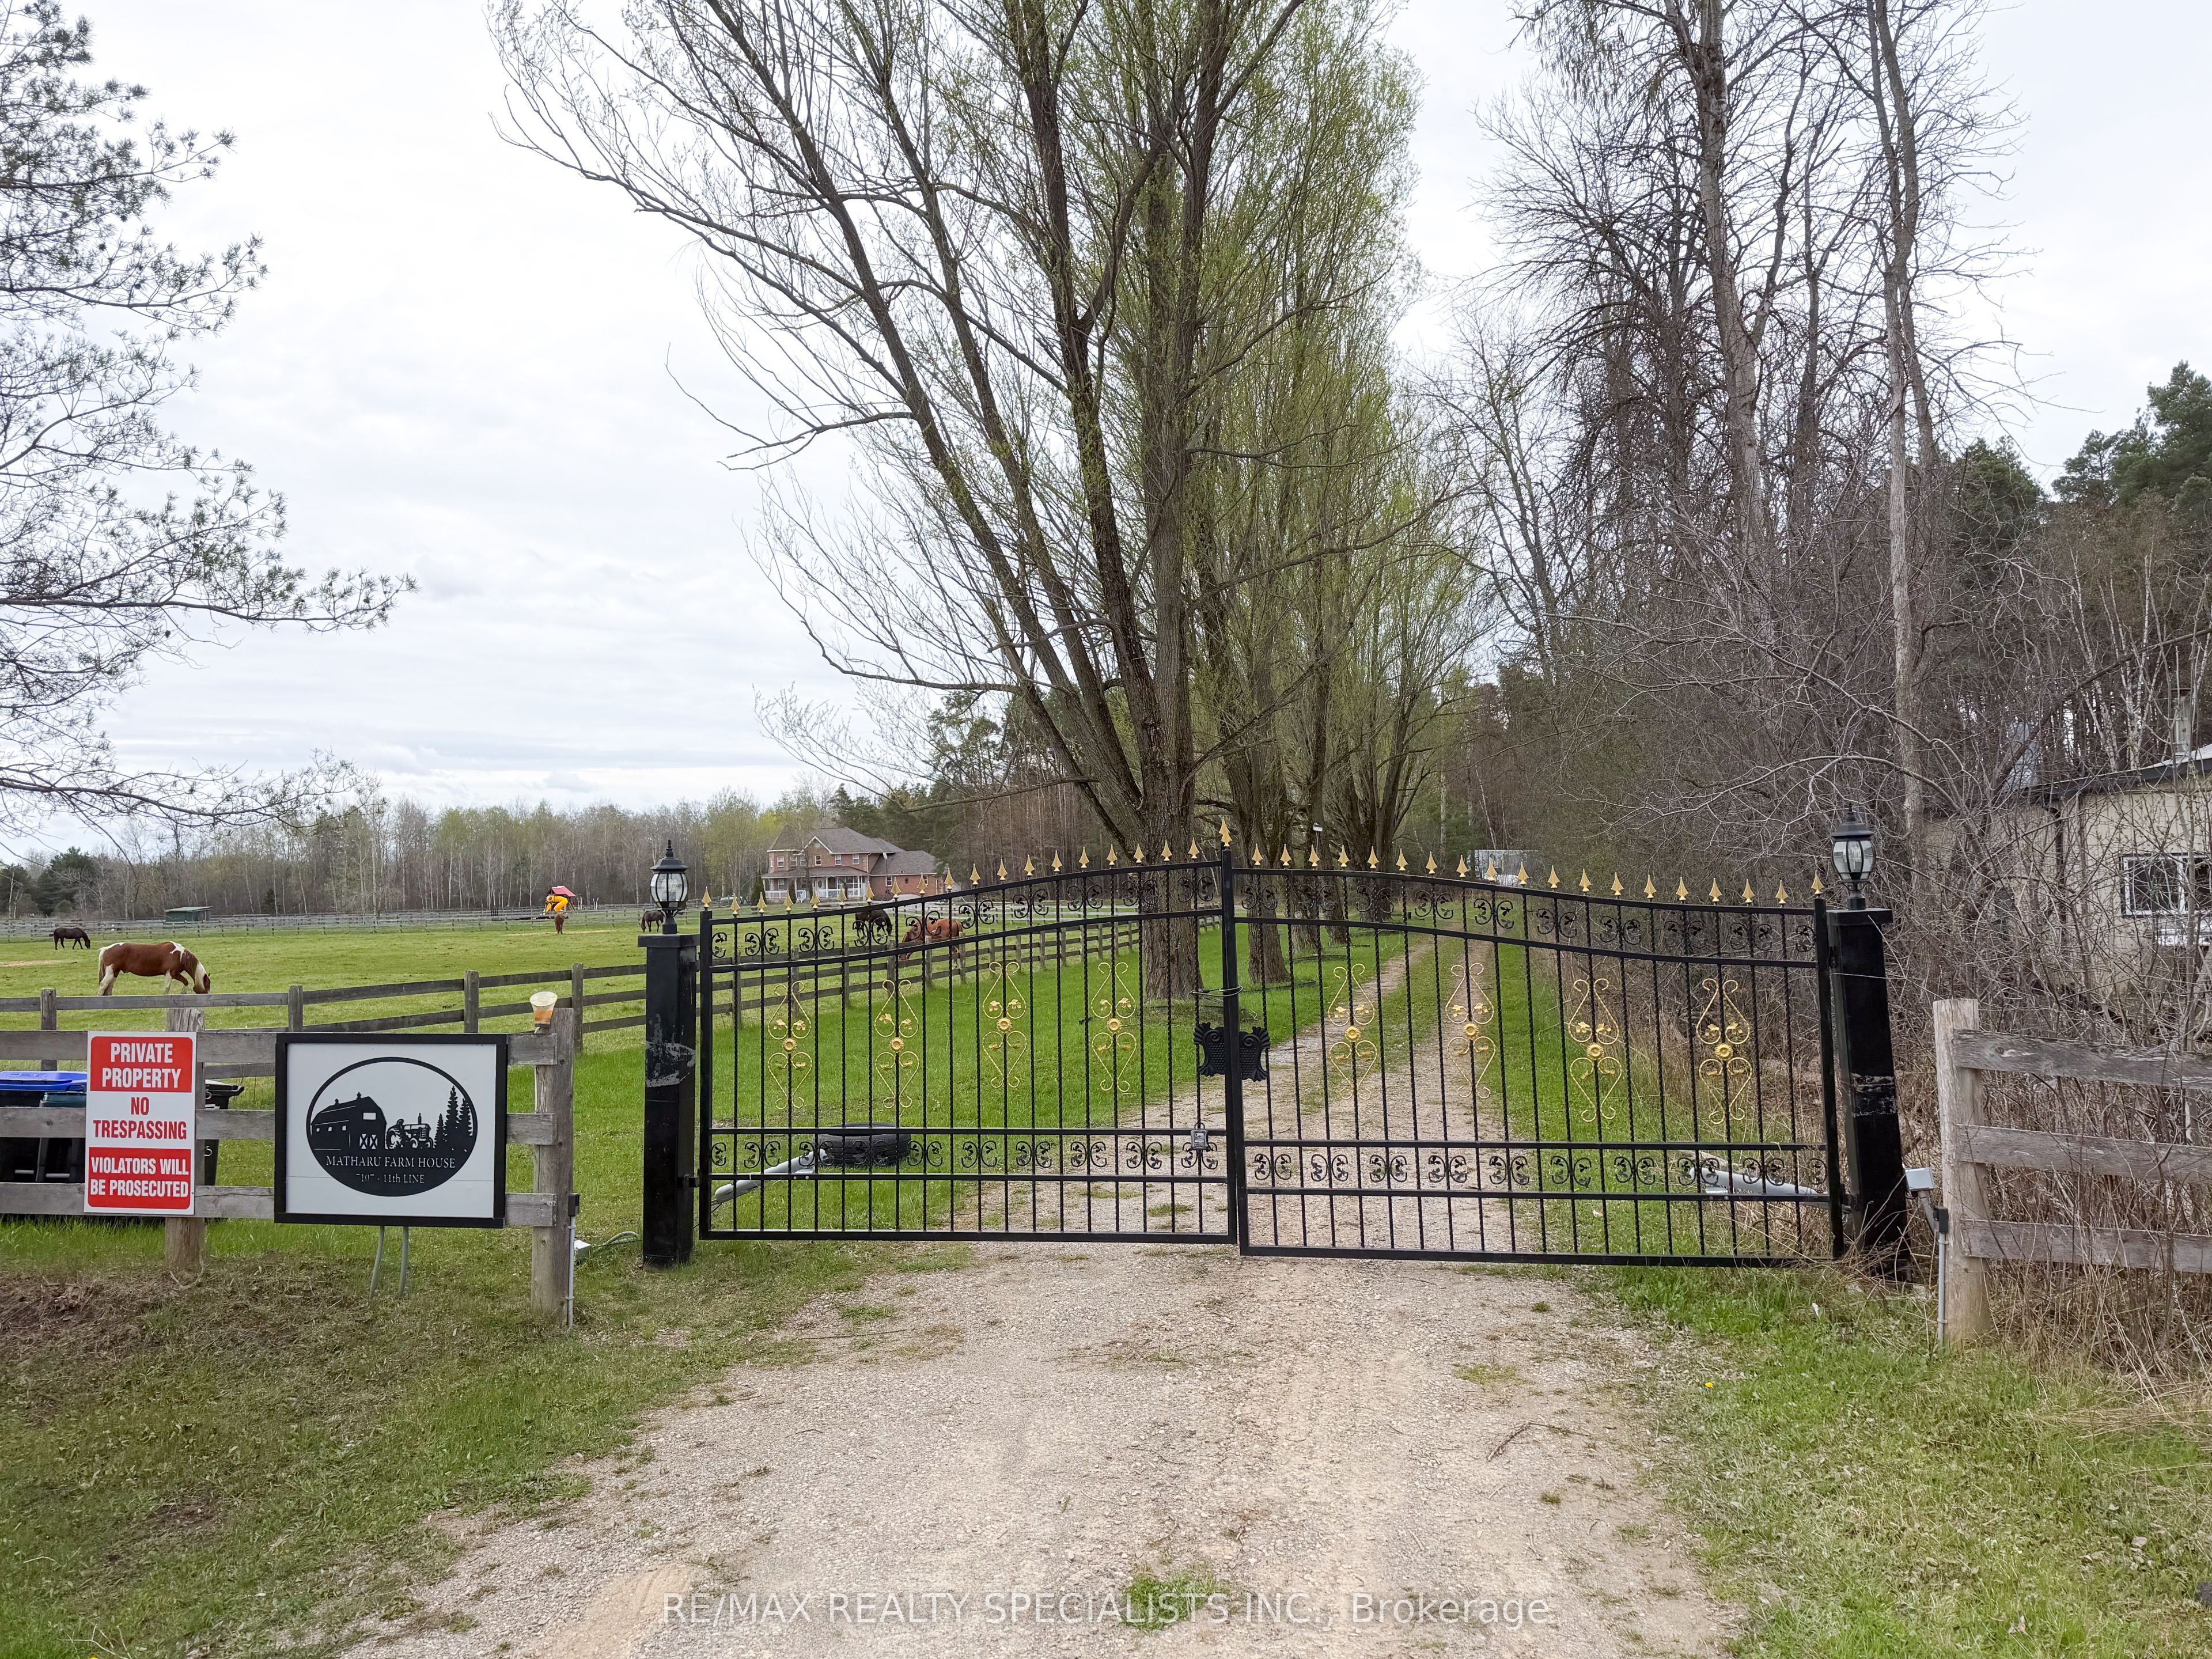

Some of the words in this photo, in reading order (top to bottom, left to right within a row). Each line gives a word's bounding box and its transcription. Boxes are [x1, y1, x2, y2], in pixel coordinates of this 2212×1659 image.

[111, 1043, 173, 1063] PRIVATE
[102, 1067, 181, 1088] PROPERTY
[131, 1097, 150, 1115] NO
[93, 1120, 187, 1140] TRESPASSING
[91, 1157, 156, 1175] VIOLATORS
[160, 1158, 189, 1175] WILL
[326, 1156, 381, 1167] MATHARU
[384, 1157, 415, 1168] FARM
[418, 1157, 456, 1168] HOUSE
[384, 1173, 400, 1183] 11th
[404, 1174, 425, 1183] LINE
[90, 1179, 105, 1195] BE
[109, 1179, 188, 1198] PROSECUTED
